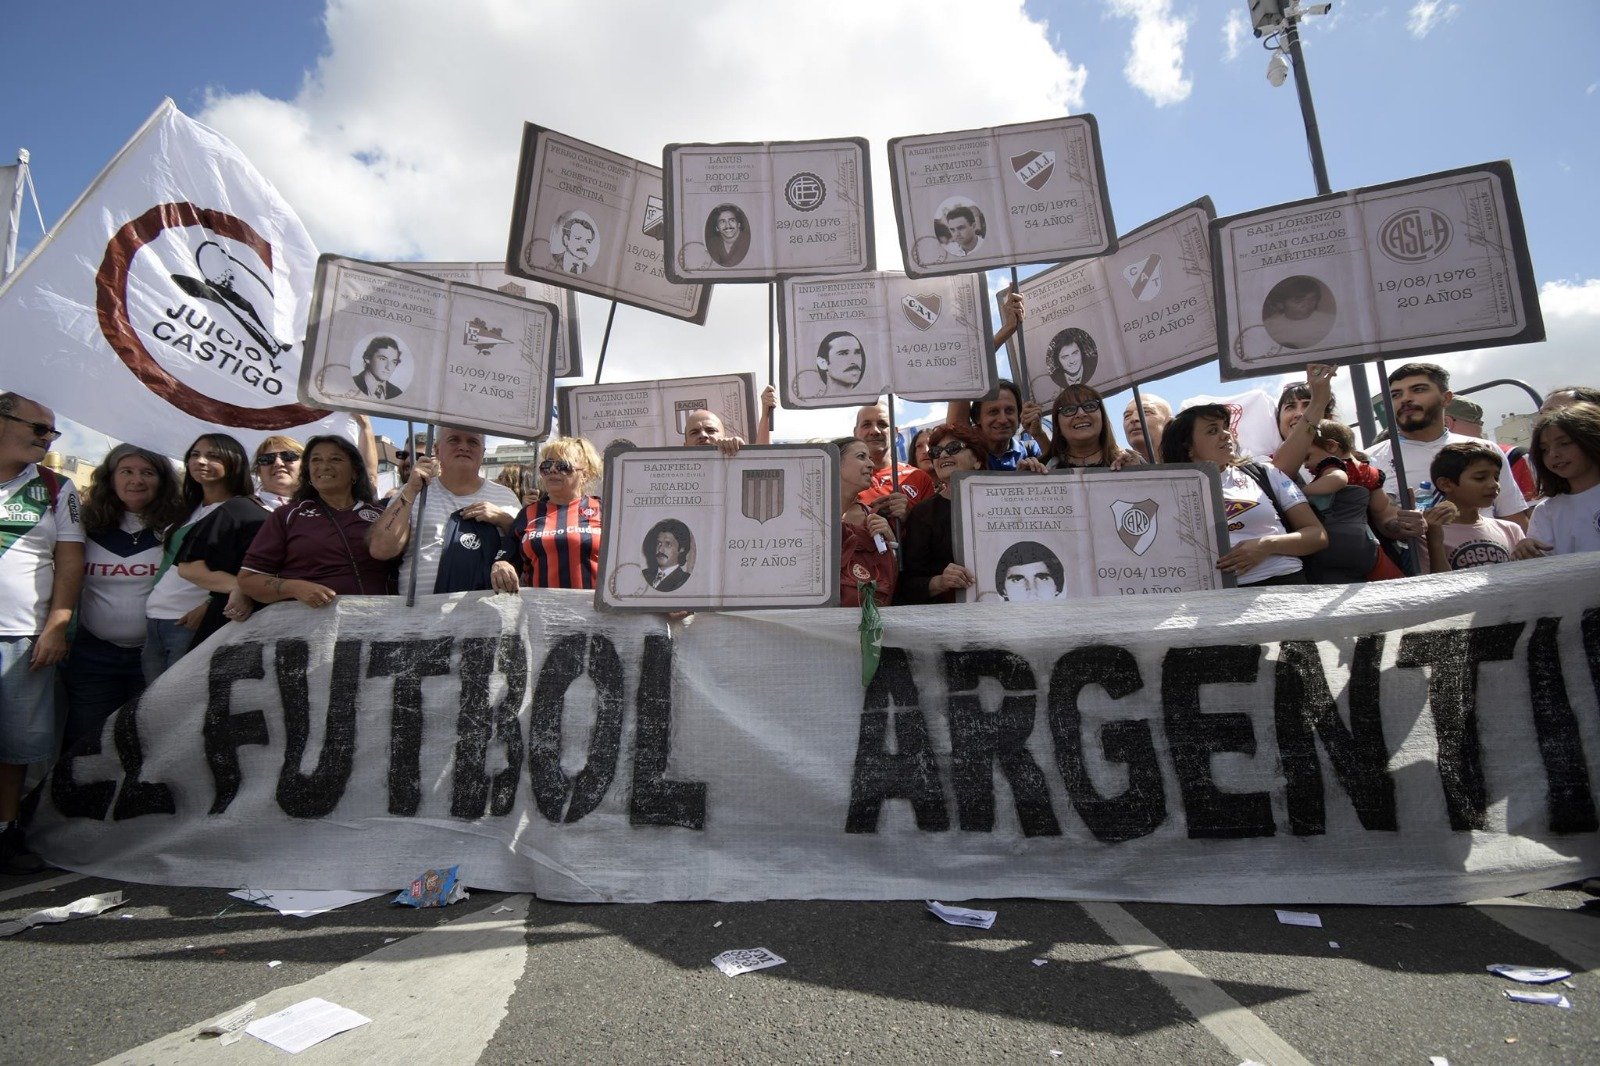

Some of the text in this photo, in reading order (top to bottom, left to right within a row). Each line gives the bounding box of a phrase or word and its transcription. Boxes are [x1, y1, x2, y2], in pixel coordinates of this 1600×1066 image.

[909, 141, 990, 156] ARGENTINOS JUNIORS
[578, 154, 606, 170] CARRIL
[608, 165, 630, 178] OESTE
[709, 156, 742, 164] LANUS
[924, 158, 982, 172] RAYMUNDO
[560, 168, 598, 186] ROBERTO
[600, 181, 618, 192] LUIS
[706, 172, 750, 180] RODOLFO
[926, 172, 972, 185] GLEYZER
[559, 181, 604, 202] CRISTINA
[1010, 198, 1078, 216] 27/05/1976
[776, 217, 840, 230] 29/03/1976
[1024, 214, 1074, 229] 34 AÑOS
[1246, 210, 1342, 236] SAN LORENZO
[790, 230, 837, 244] 26 AÑOS
[1251, 228, 1346, 254] JUAN CARLOS
[1262, 244, 1336, 266] MARTINEZ
[634, 262, 648, 272] 37
[1026, 269, 1085, 300] TEMPERLEY
[1378, 268, 1476, 292] 19/08/1976
[798, 282, 876, 294] INDEPENDIENTE
[814, 298, 868, 308] RAIMUNDO
[1030, 298, 1058, 316] PABLO
[1060, 284, 1095, 302] DANIEL
[1398, 288, 1473, 308] 20 AÑOS
[361, 306, 412, 323] UNGARO
[402, 302, 435, 316] ANGEL
[809, 310, 865, 320] VILLAFLOR
[1041, 304, 1075, 324] MUSSO
[1123, 296, 1198, 332] 25/10/1976
[1138, 315, 1196, 343] 26 AÑOS
[166, 304, 282, 374] JUICIO Y
[896, 342, 962, 354] 14/08/1979
[152, 321, 283, 396] CASTIGO
[908, 355, 956, 368] 45 AÑOS
[449, 364, 520, 386] 16/09/1976
[463, 382, 514, 400] 17 AÑOS
[588, 392, 648, 402] RACING CLUB
[594, 407, 648, 418] ALEJANDRO
[596, 420, 638, 429] ALMEIDA
[644, 463, 702, 472] BANFIELD
[746, 470, 780, 478] BANFIELD
[650, 482, 700, 490] RICARDO
[986, 486, 1068, 496] RIVER PLATE
[633, 496, 702, 506] CHIDICHIMO
[987, 506, 1073, 516] JUAN CARLOS
[987, 520, 1062, 530] MARDIKIAN
[528, 528, 564, 540] Banco
[728, 538, 803, 550] 20/11/1976
[740, 554, 797, 567] 27 AÑOS
[1098, 566, 1186, 580] 09/04/1976
[204, 633, 708, 830] FUTBOL
[845, 607, 1600, 842] ARGENTI
